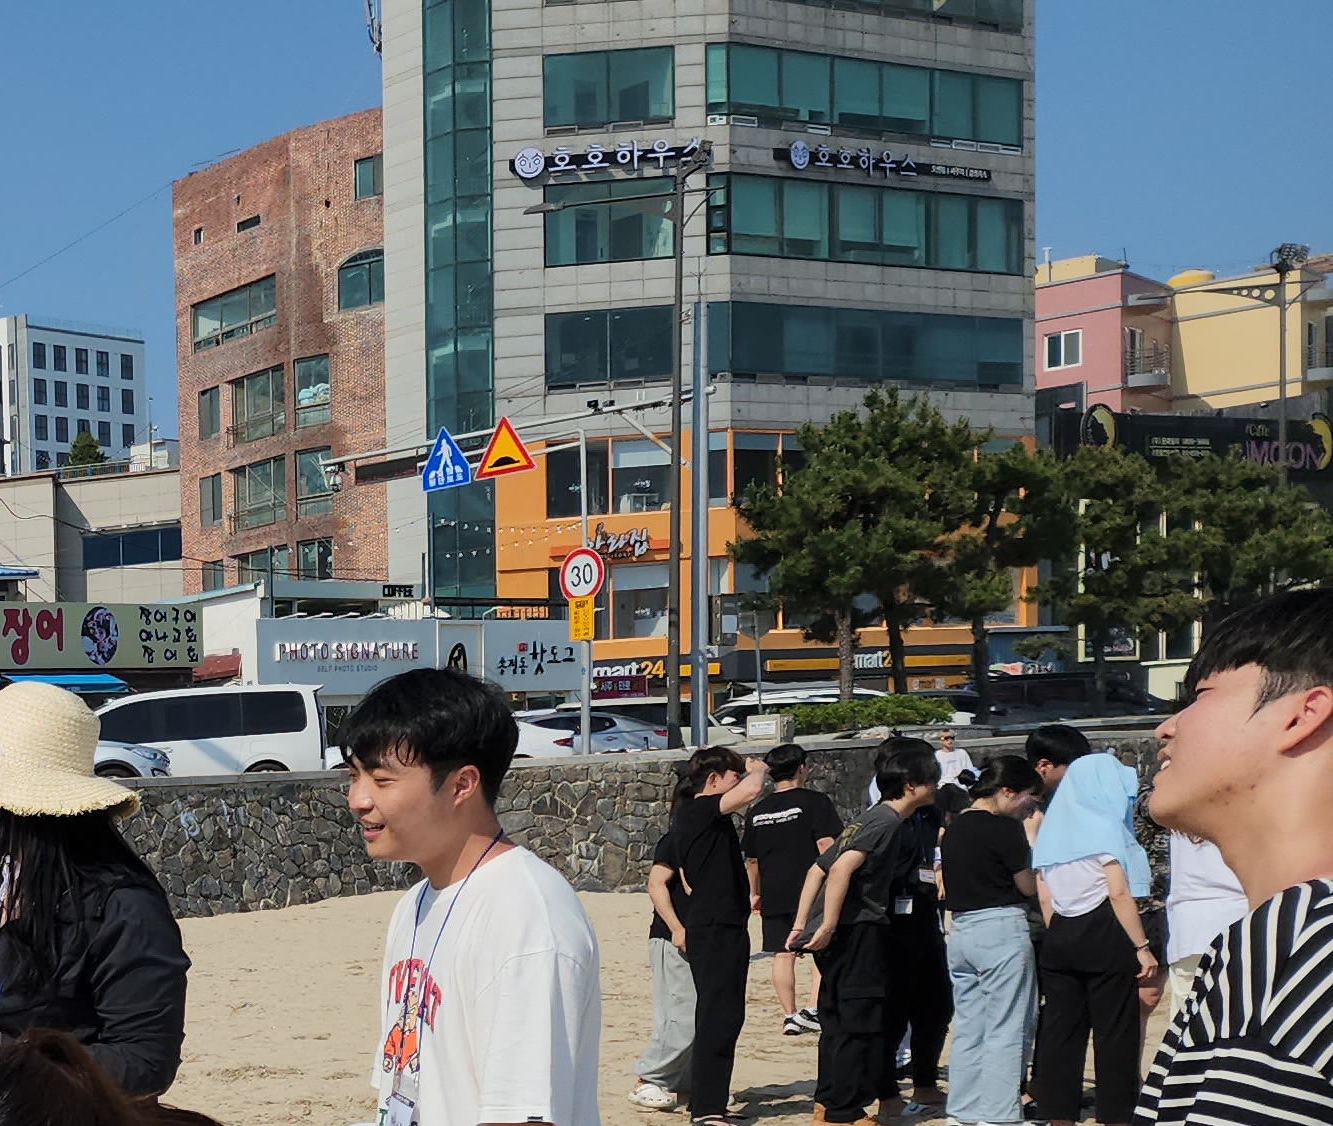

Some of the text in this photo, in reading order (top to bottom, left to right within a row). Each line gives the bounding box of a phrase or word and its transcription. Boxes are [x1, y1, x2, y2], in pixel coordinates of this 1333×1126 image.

[815, 143, 918, 177] 호호하우스
[570, 562, 594, 588] 30
[383, 584, 415, 598] COFFEE
[138, 626, 198, 643] 아나고회
[275, 641, 420, 661] PHOTO SIGNATURE
